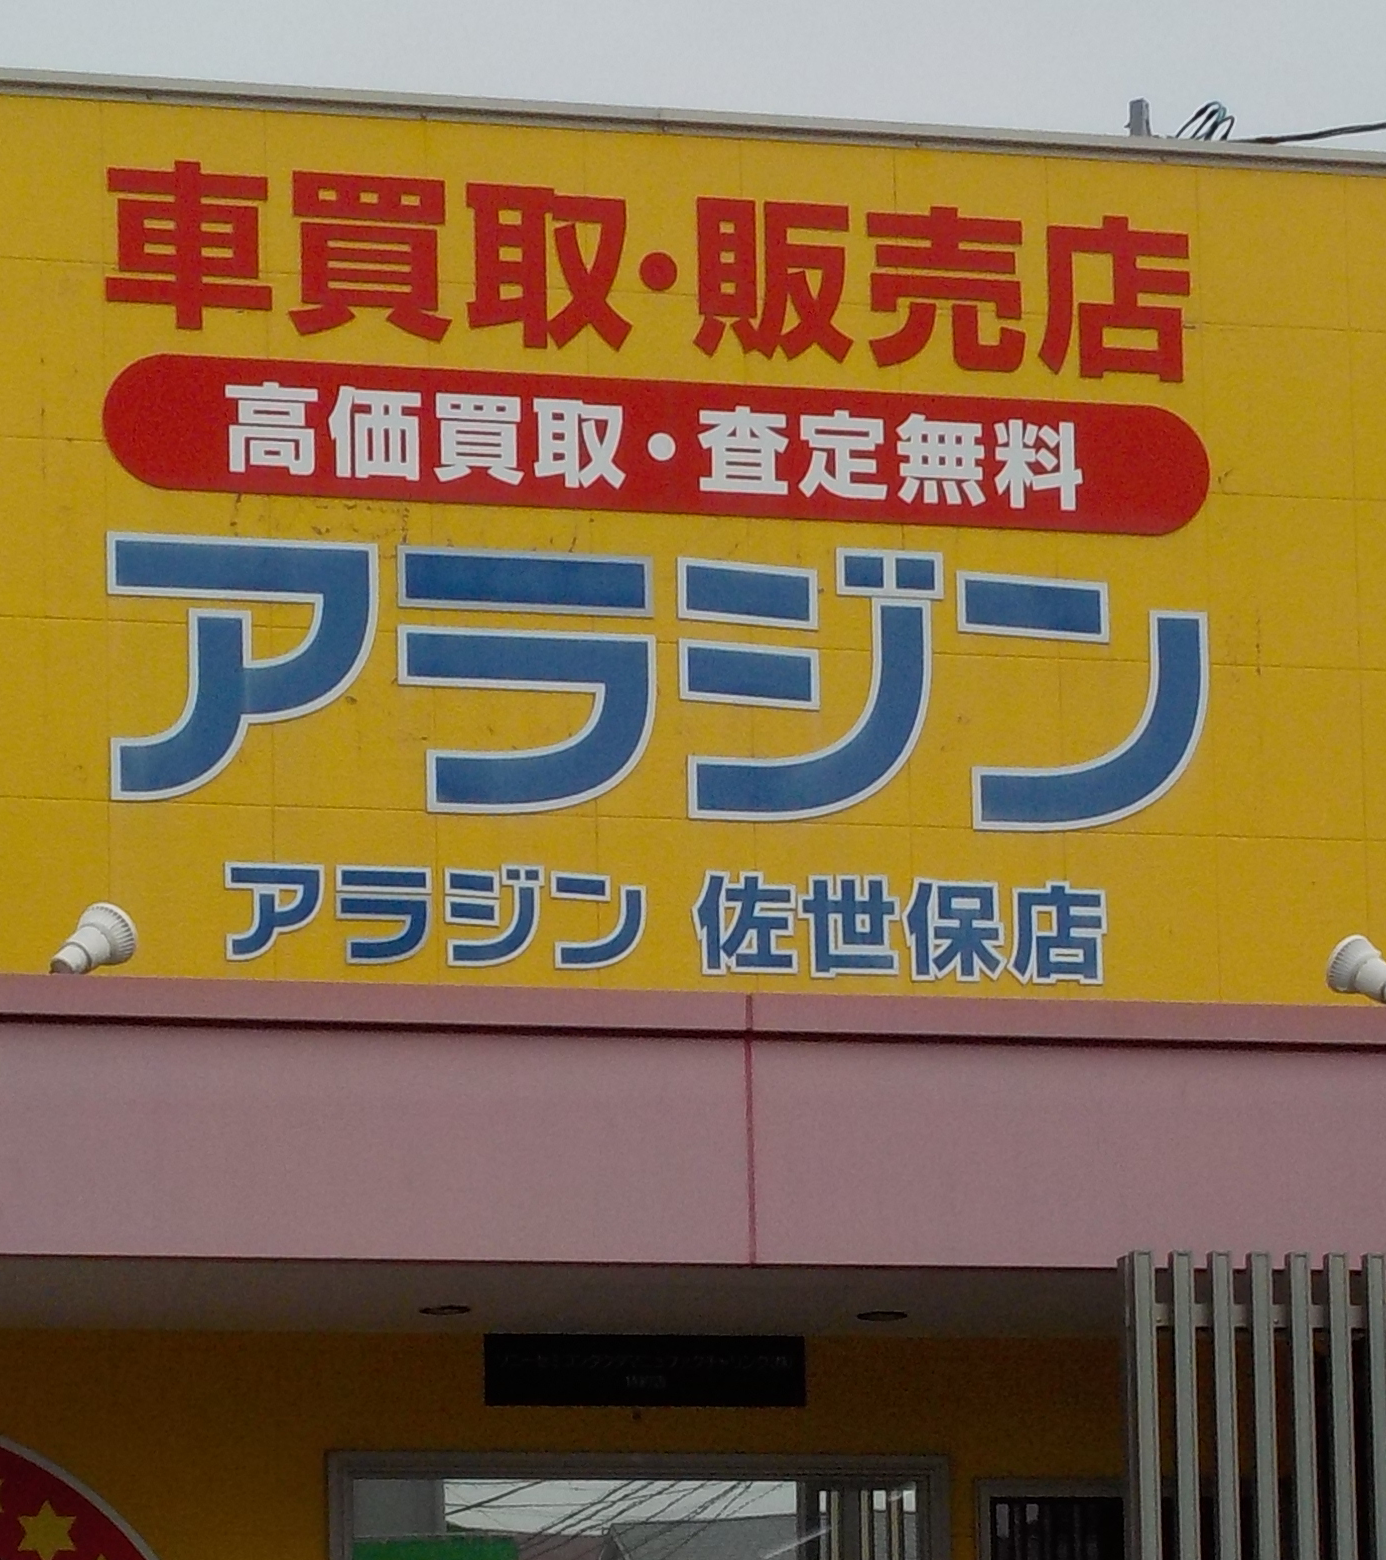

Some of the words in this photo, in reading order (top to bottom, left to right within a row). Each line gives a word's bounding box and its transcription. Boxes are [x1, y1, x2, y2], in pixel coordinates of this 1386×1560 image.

[105, 160, 1191, 383] 車買取・販売店
[224, 381, 1084, 512] 高価買取・査定無料
[107, 530, 1208, 832] アラジン
[224, 860, 647, 971] アラジン
[691, 870, 1106, 985] 佐世保店
